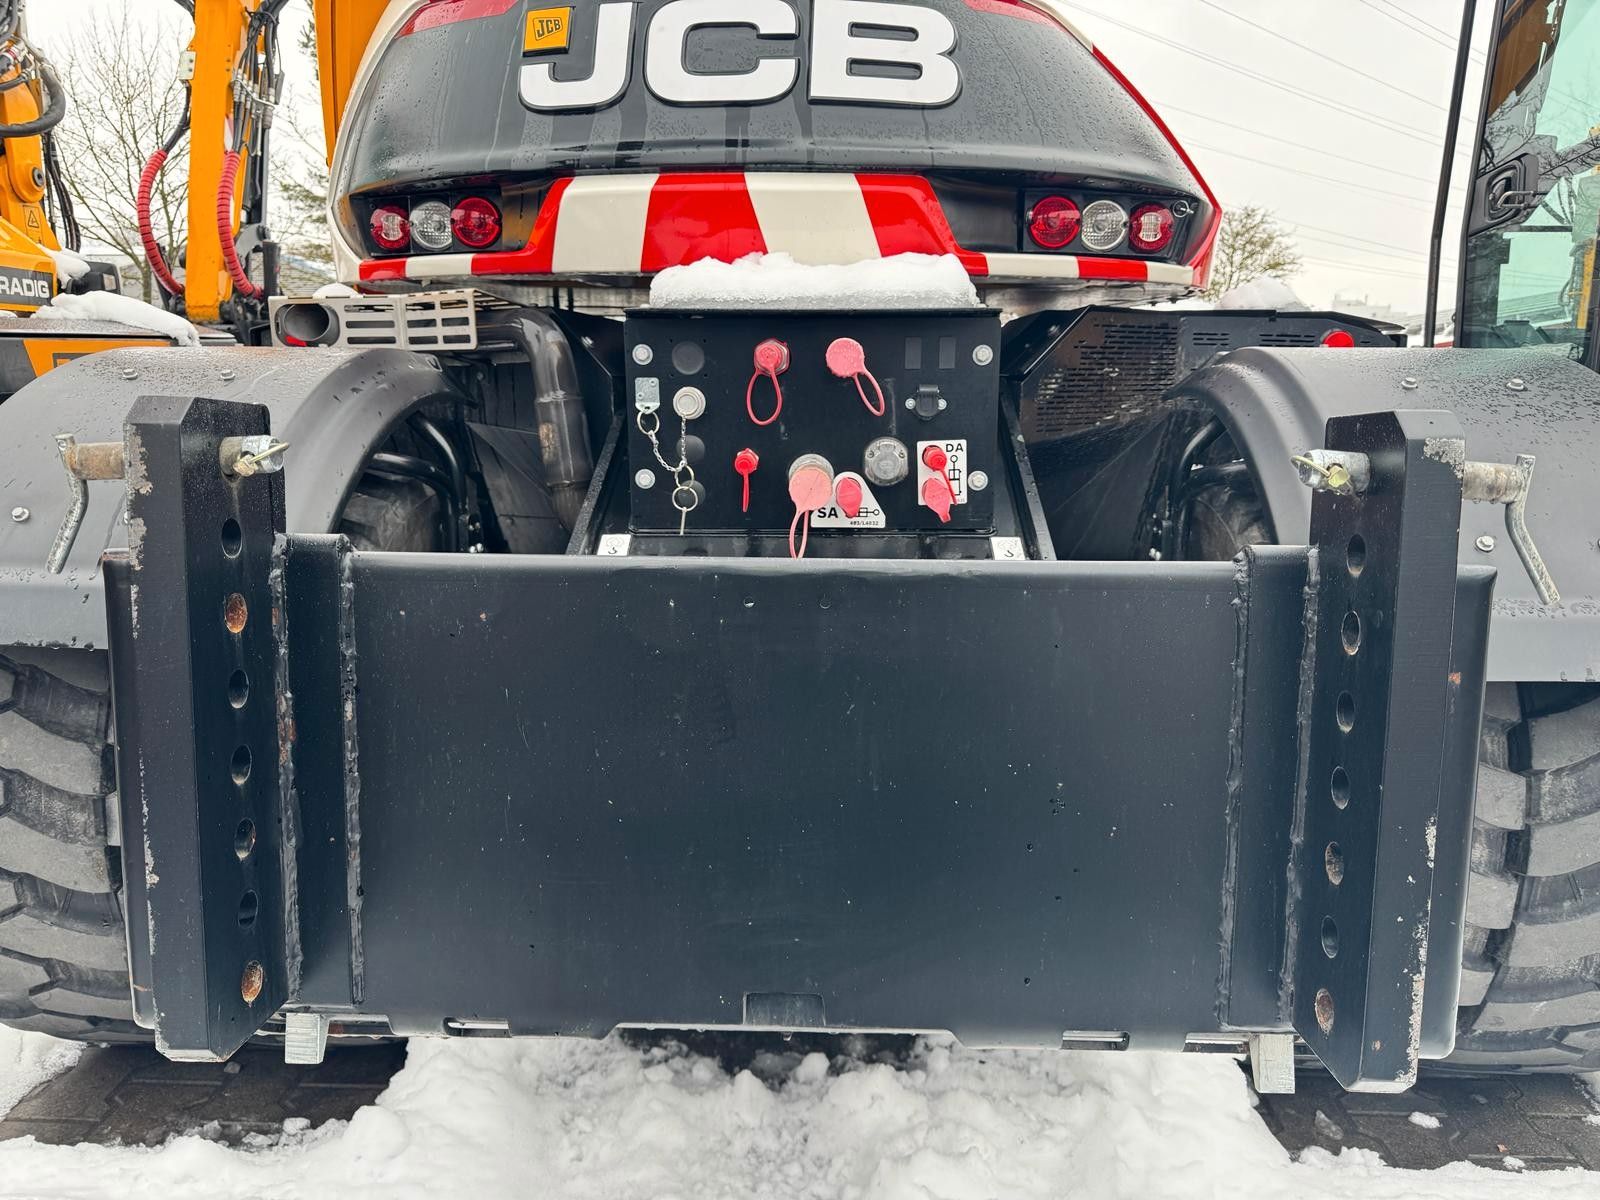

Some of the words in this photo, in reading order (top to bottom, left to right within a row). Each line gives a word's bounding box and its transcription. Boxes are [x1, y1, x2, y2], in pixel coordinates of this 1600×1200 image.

[536, 19, 561, 38] JCB
[519, 0, 961, 108] JCB
[0, 276, 50, 298] RADIG
[945, 443, 964, 453] DA
[817, 507, 839, 519] SA
